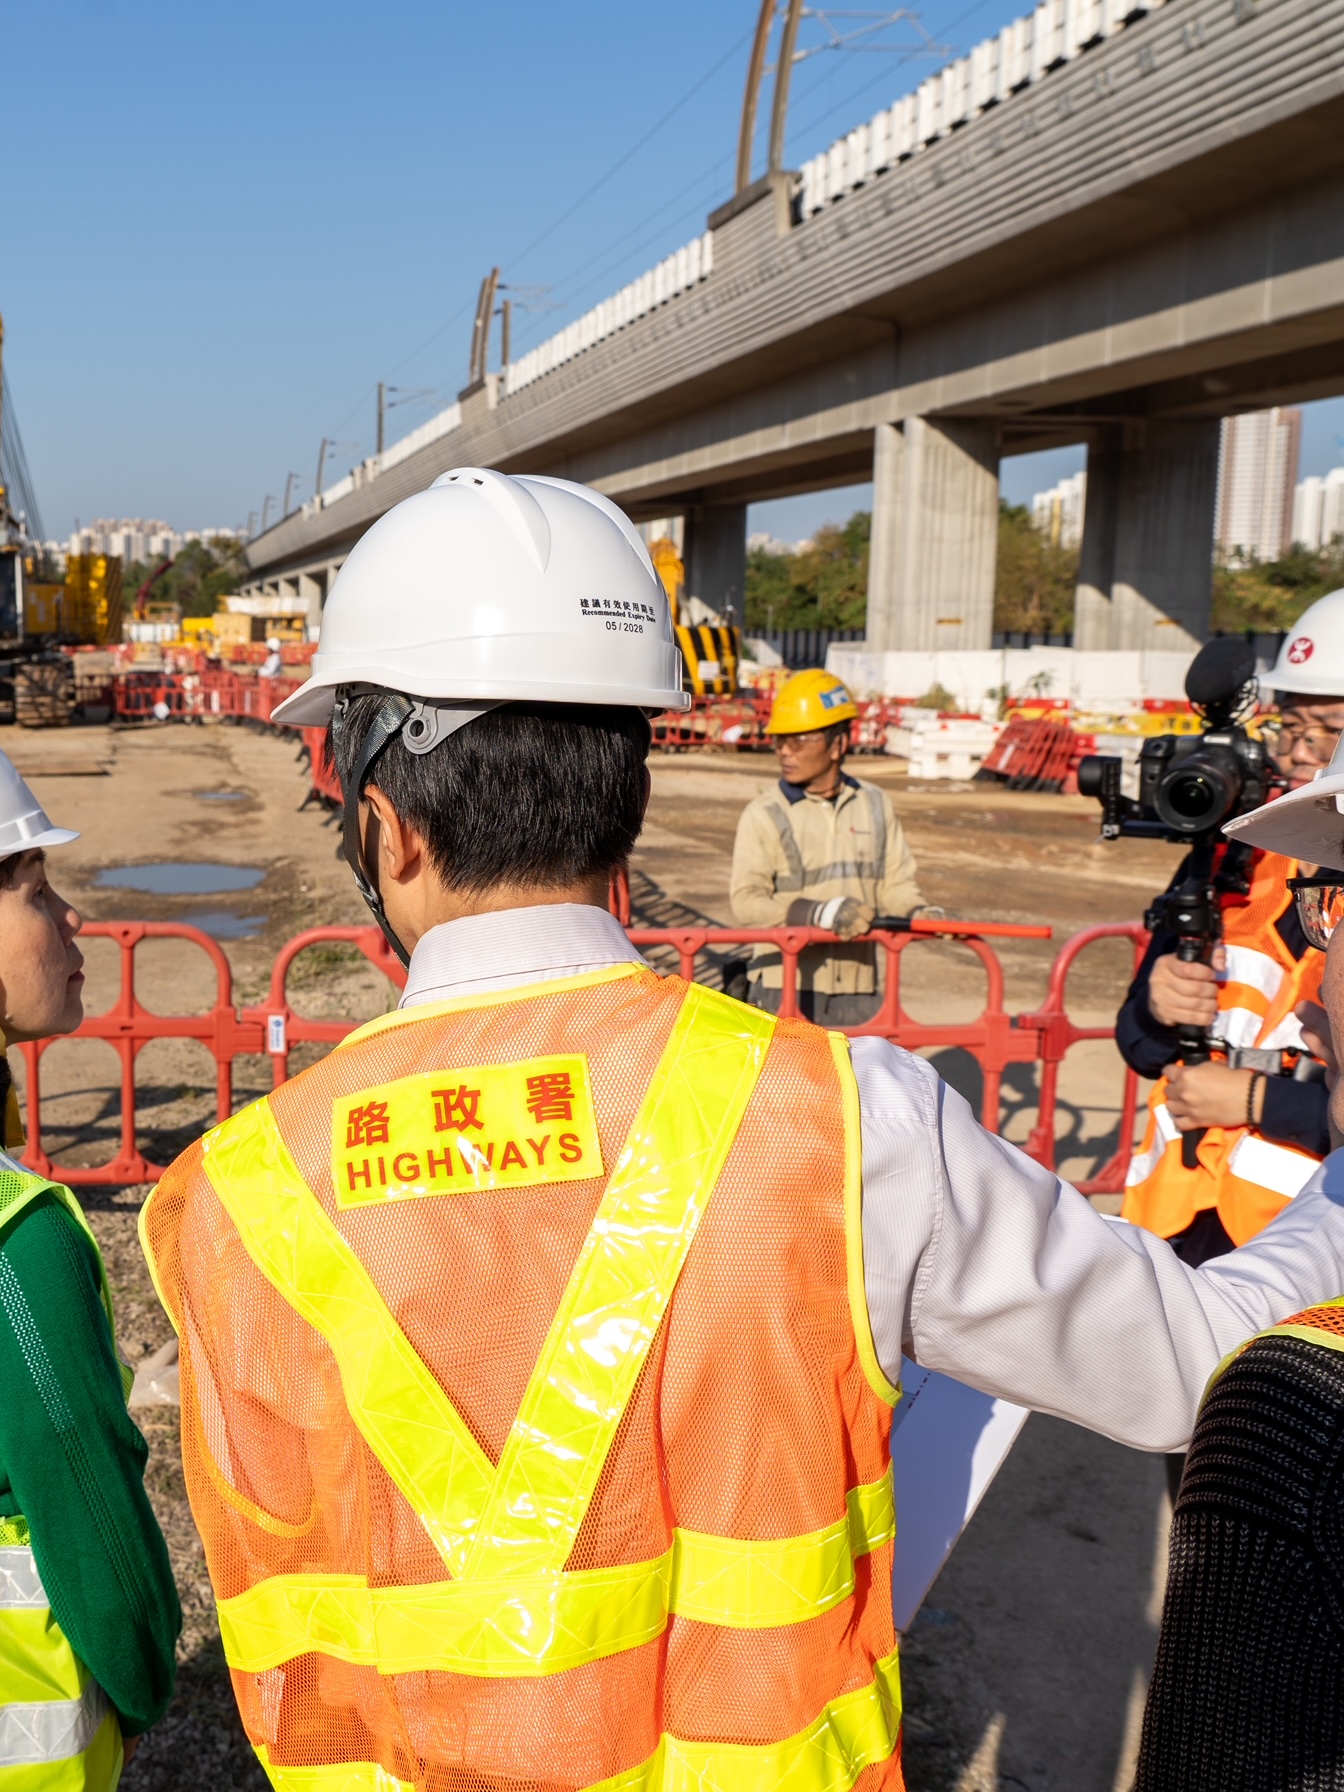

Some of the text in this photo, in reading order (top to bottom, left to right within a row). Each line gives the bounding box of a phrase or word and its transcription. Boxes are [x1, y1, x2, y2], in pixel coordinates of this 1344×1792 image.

[582, 609, 626, 617] Recommended
[628, 612, 645, 621] Expiry
[605, 620, 617, 631] 05
[623, 622, 644, 634] 2028
[345, 1072, 575, 1149] 路政署
[346, 1132, 584, 1191] HIGHWAYS
